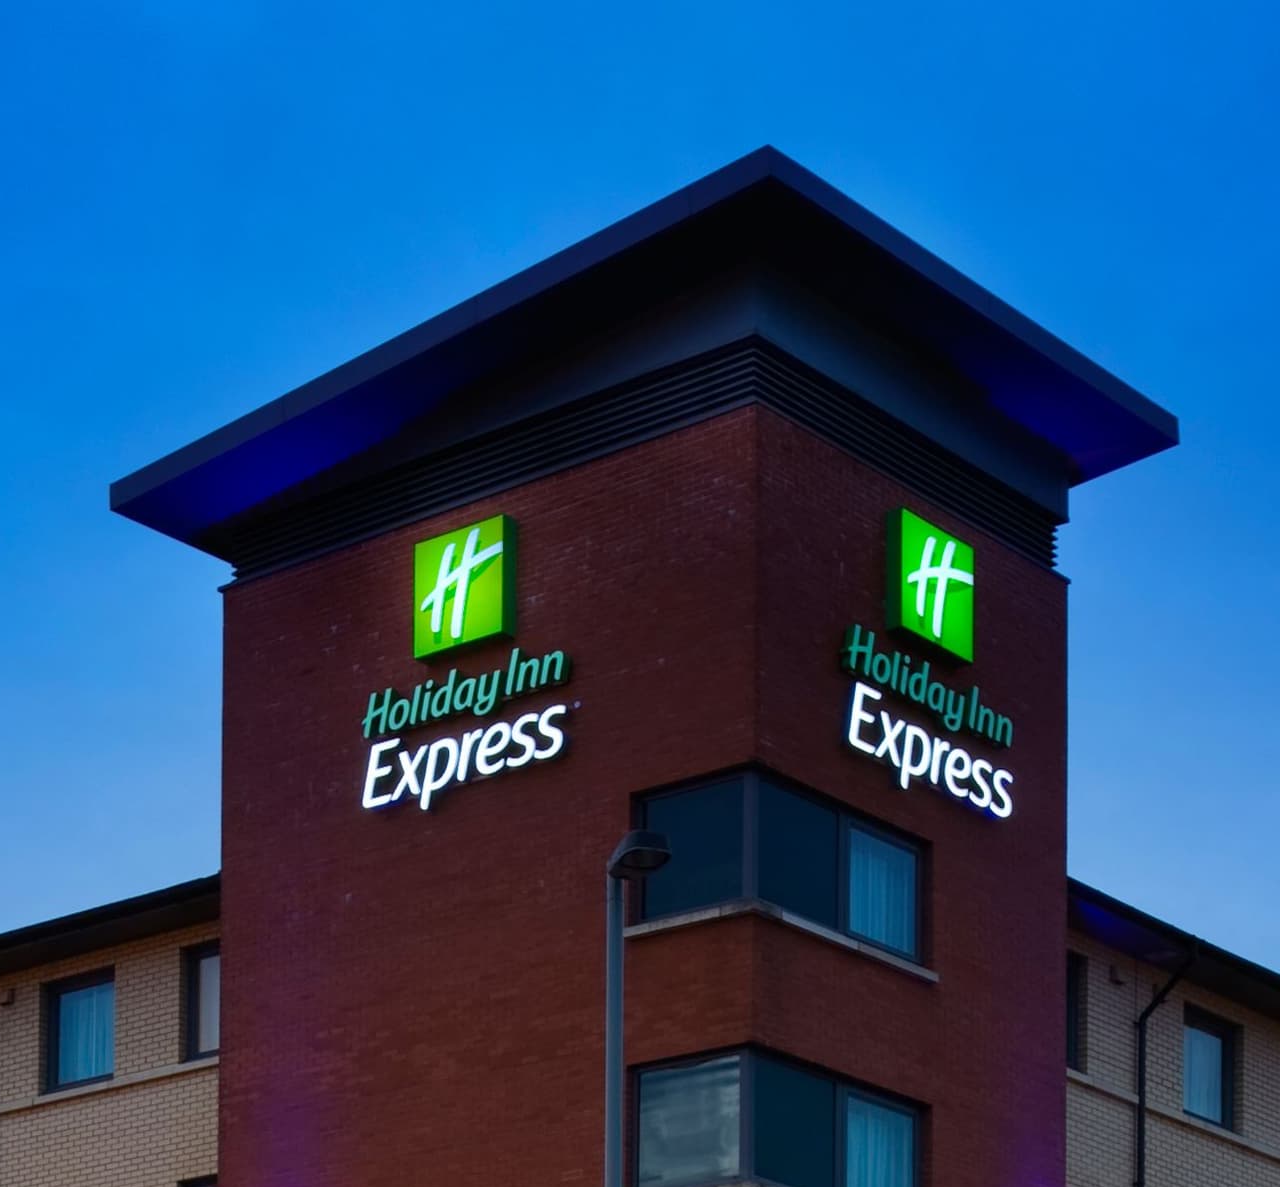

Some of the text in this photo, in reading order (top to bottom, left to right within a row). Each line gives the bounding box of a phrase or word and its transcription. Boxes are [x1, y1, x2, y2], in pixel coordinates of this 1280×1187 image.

[362, 648, 564, 738] Holiday Inn
[848, 624, 1013, 748] Holiday Inn
[362, 704, 566, 810] Express
[848, 681, 1013, 818] Express
